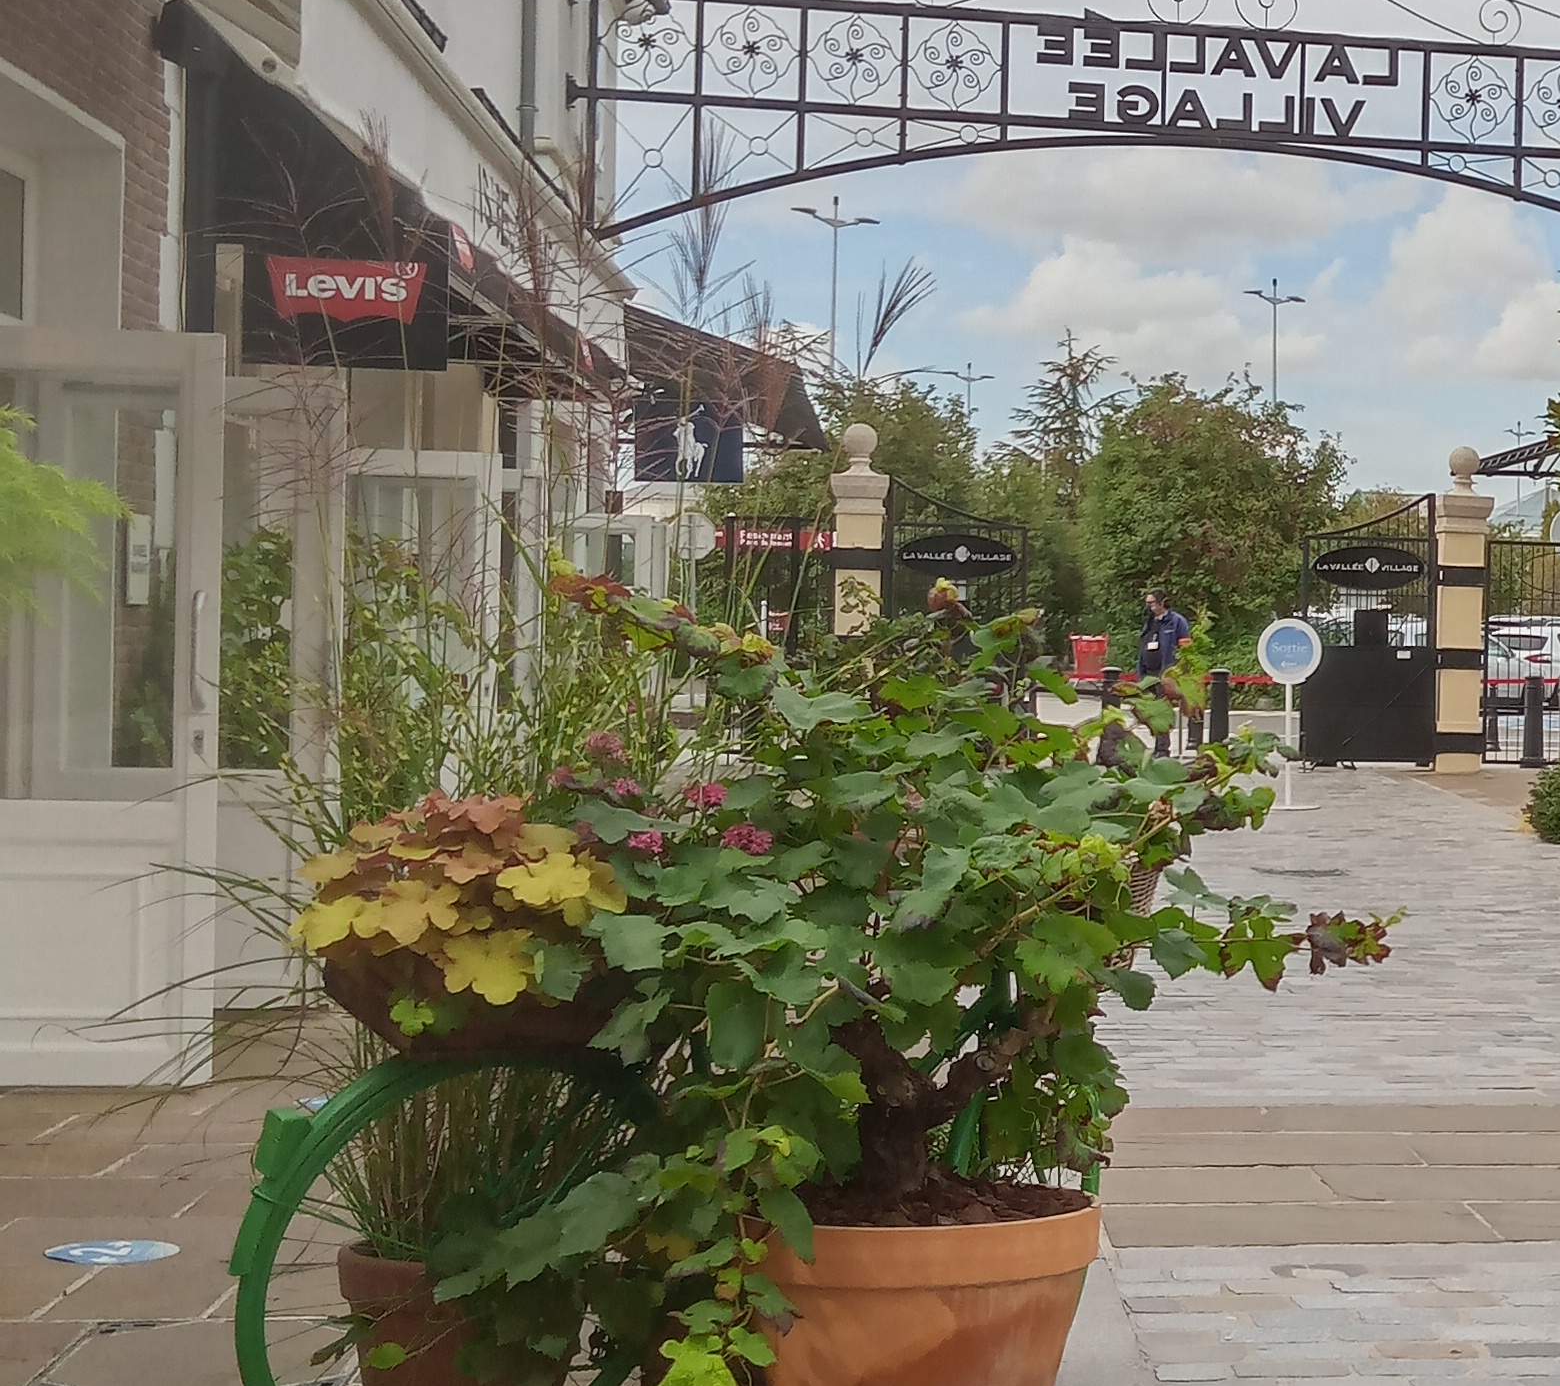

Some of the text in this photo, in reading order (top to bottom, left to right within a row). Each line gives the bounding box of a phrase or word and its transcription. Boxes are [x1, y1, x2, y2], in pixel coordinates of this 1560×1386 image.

[970, 554, 1012, 562] VILLAGE
[1381, 563, 1419, 572] VILLAGE
[1271, 642, 1308, 653] Sortie
